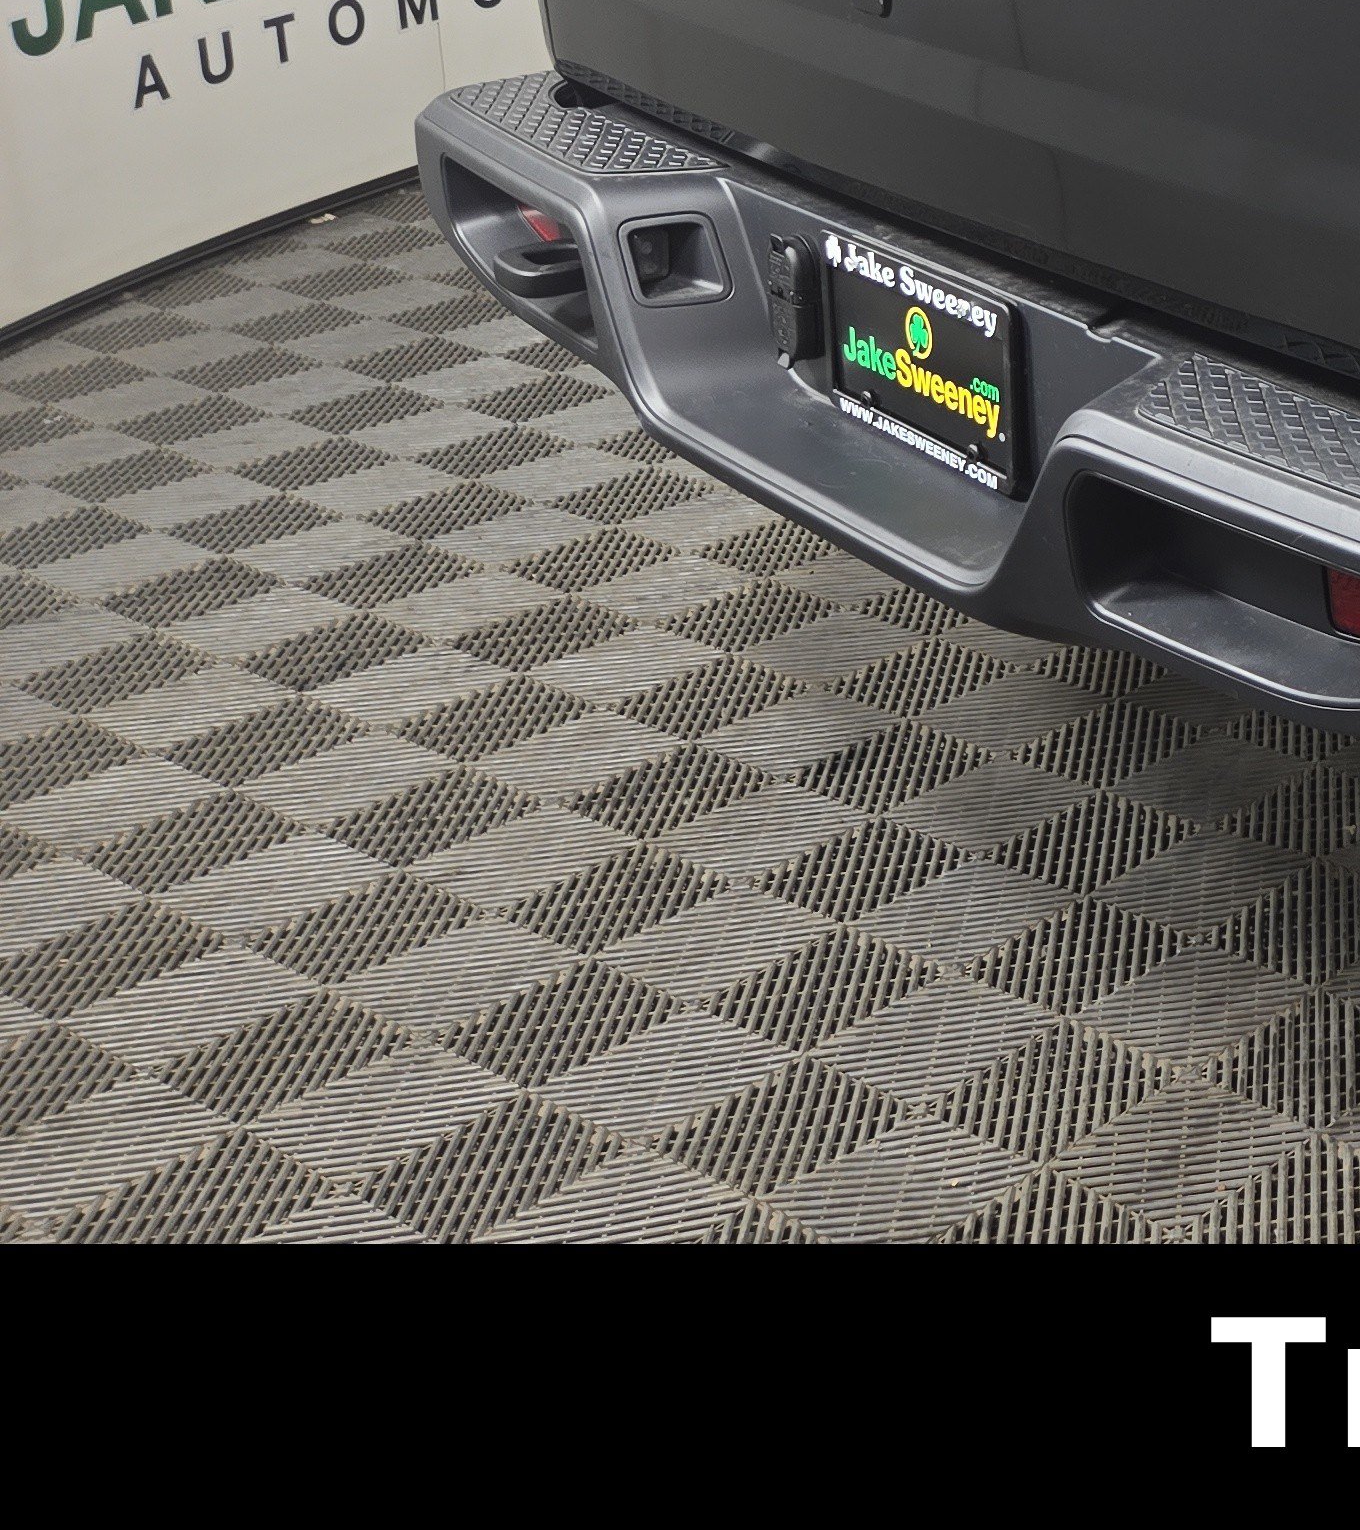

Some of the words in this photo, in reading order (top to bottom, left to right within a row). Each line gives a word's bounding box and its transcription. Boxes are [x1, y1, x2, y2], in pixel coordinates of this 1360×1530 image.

[843, 243, 896, 288] Jake
[899, 265, 998, 338] Sweeney
[843, 325, 1001, 439] JakeSweeney
[969, 377, 1000, 403] .com
[839, 396, 998, 490] WWW.JAKESWEENEY.COM
